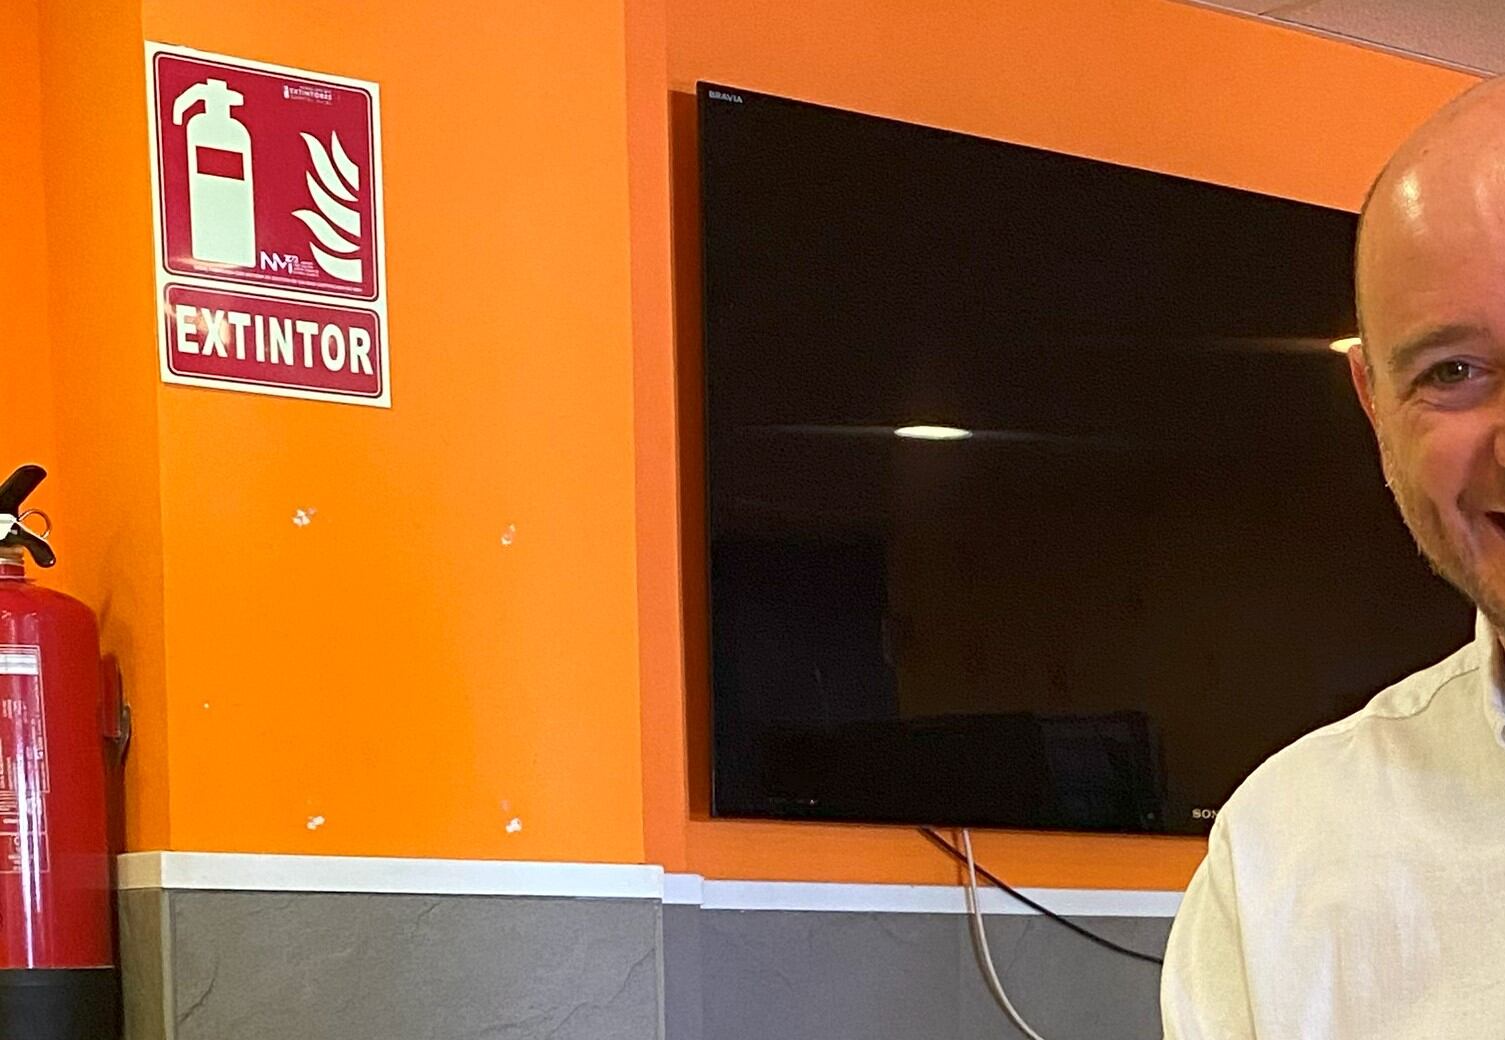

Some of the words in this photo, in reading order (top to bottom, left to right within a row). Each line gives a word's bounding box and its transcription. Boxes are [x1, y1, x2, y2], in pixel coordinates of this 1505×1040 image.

[708, 90, 743, 104] BRAVIA
[175, 303, 374, 375] EXTINTOR
[1192, 808, 1218, 819] SON
